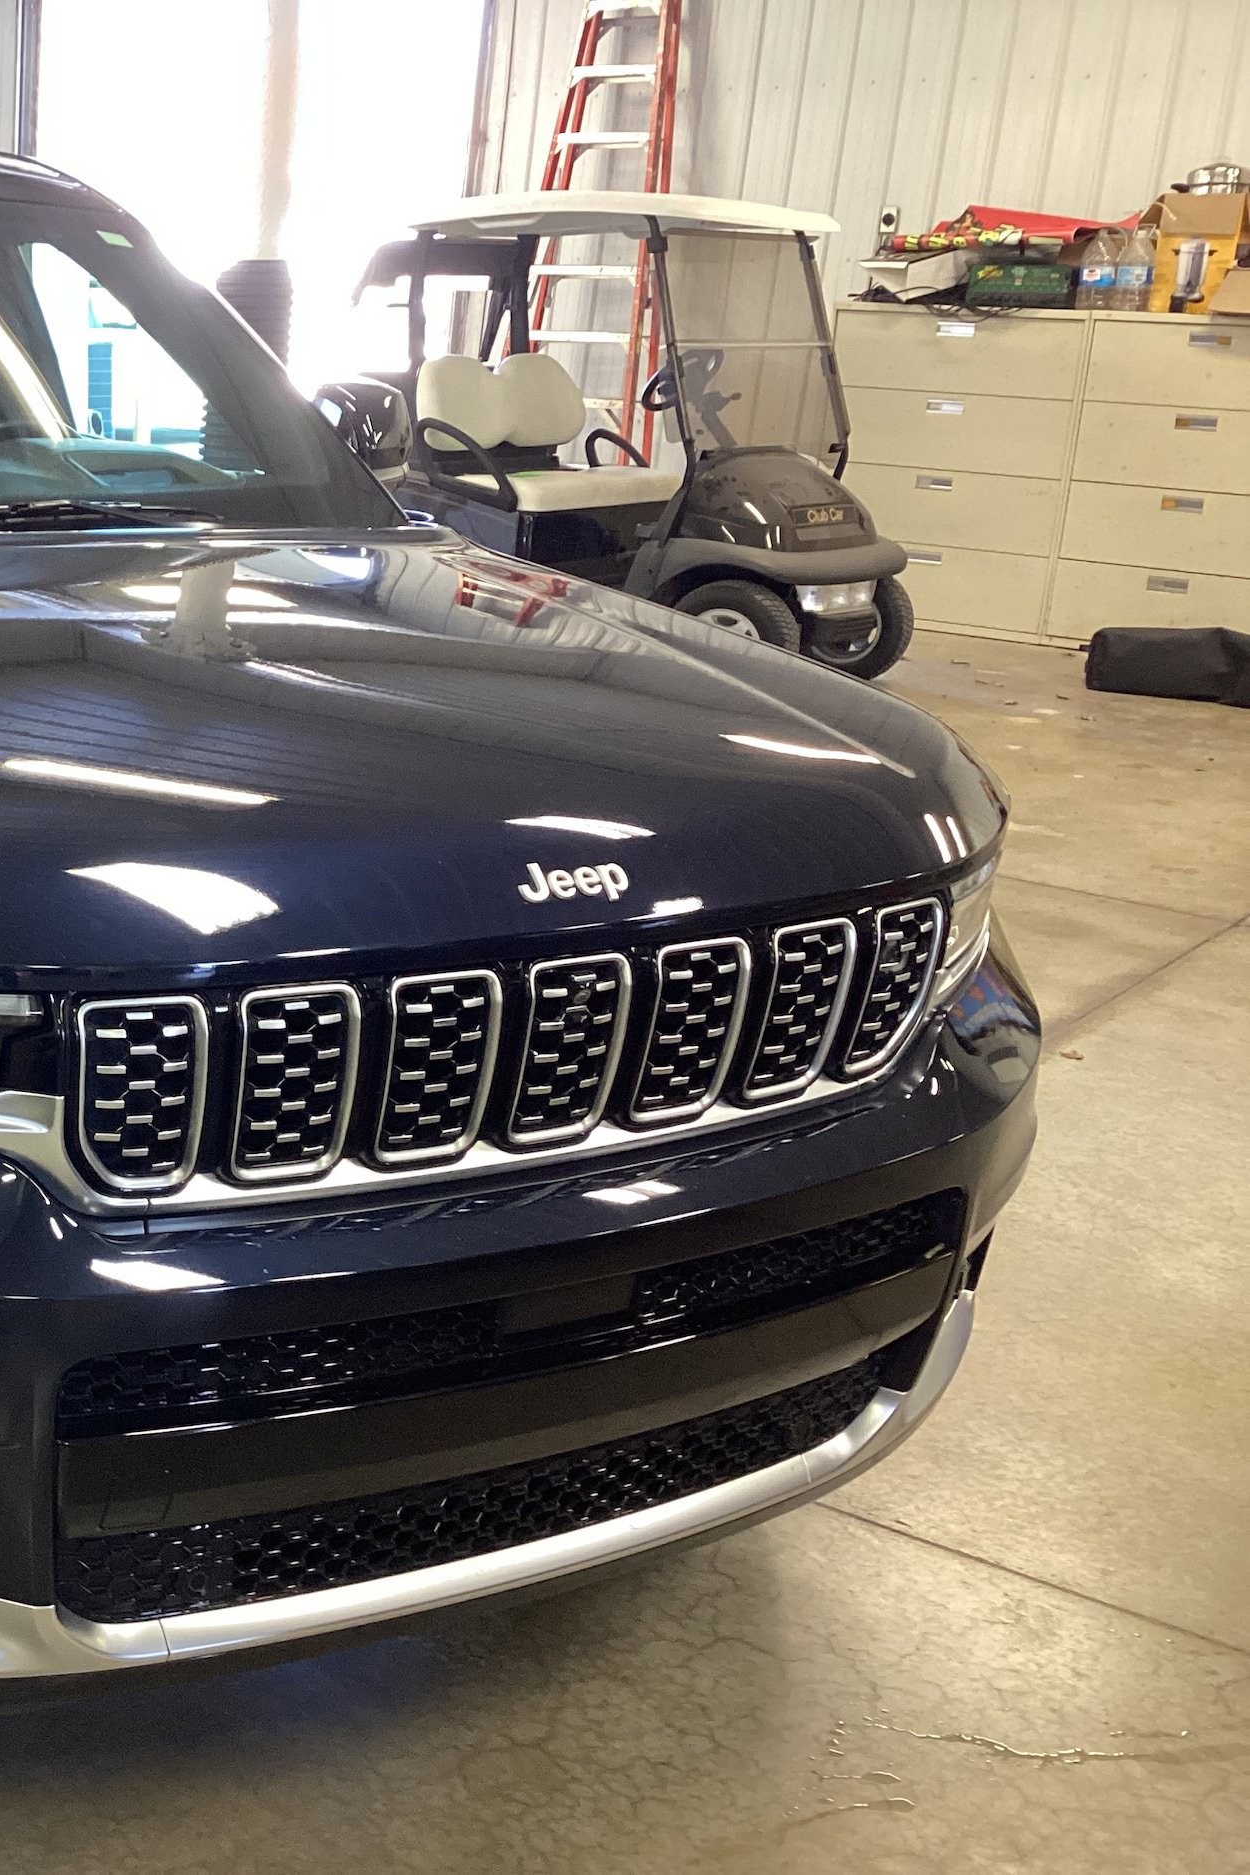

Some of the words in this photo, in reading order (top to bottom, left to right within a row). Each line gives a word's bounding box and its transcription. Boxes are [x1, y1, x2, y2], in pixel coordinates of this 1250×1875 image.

[807, 508, 829, 523] Club
[830, 507, 844, 521] Car
[517, 862, 629, 903] Jeep
